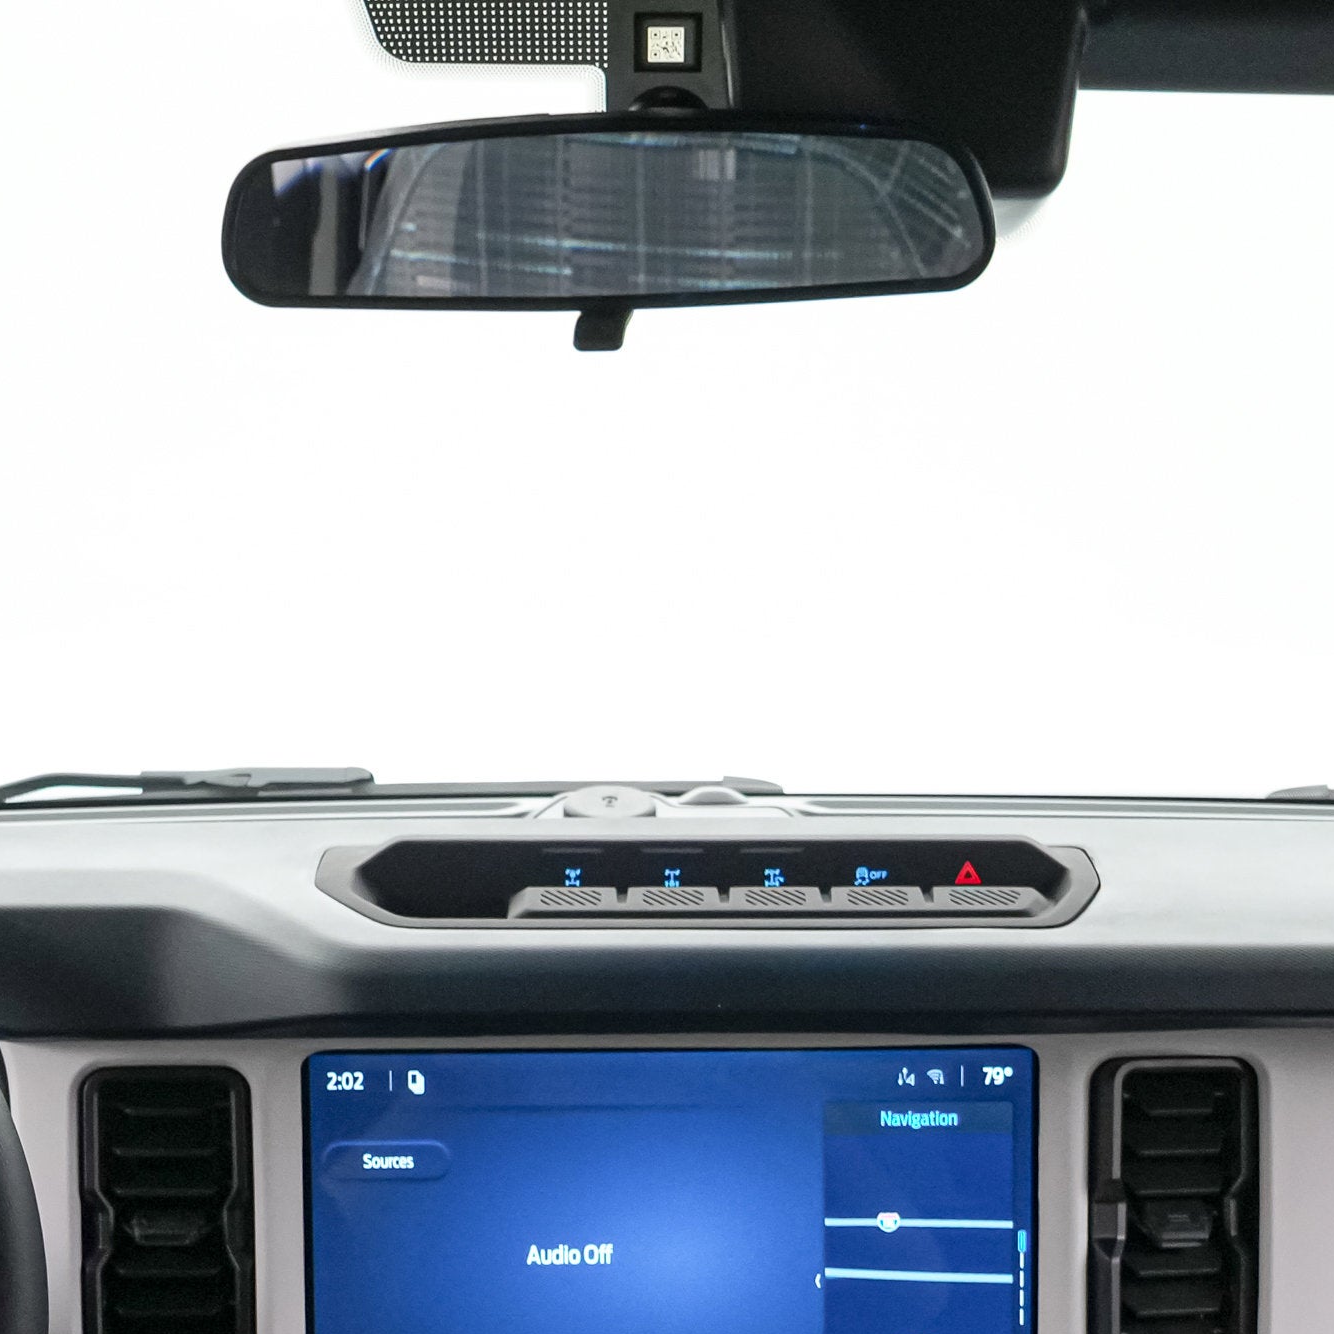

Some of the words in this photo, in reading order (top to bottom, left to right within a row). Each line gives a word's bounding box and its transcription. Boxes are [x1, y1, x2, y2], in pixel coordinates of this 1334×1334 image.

[869, 869, 888, 881] OFF
[326, 1071, 364, 1091] 2:02
[880, 1110, 958, 1130] Navigation
[362, 1153, 415, 1171] Sources
[526, 1243, 580, 1266] Audio
[583, 1243, 614, 1266] Off
